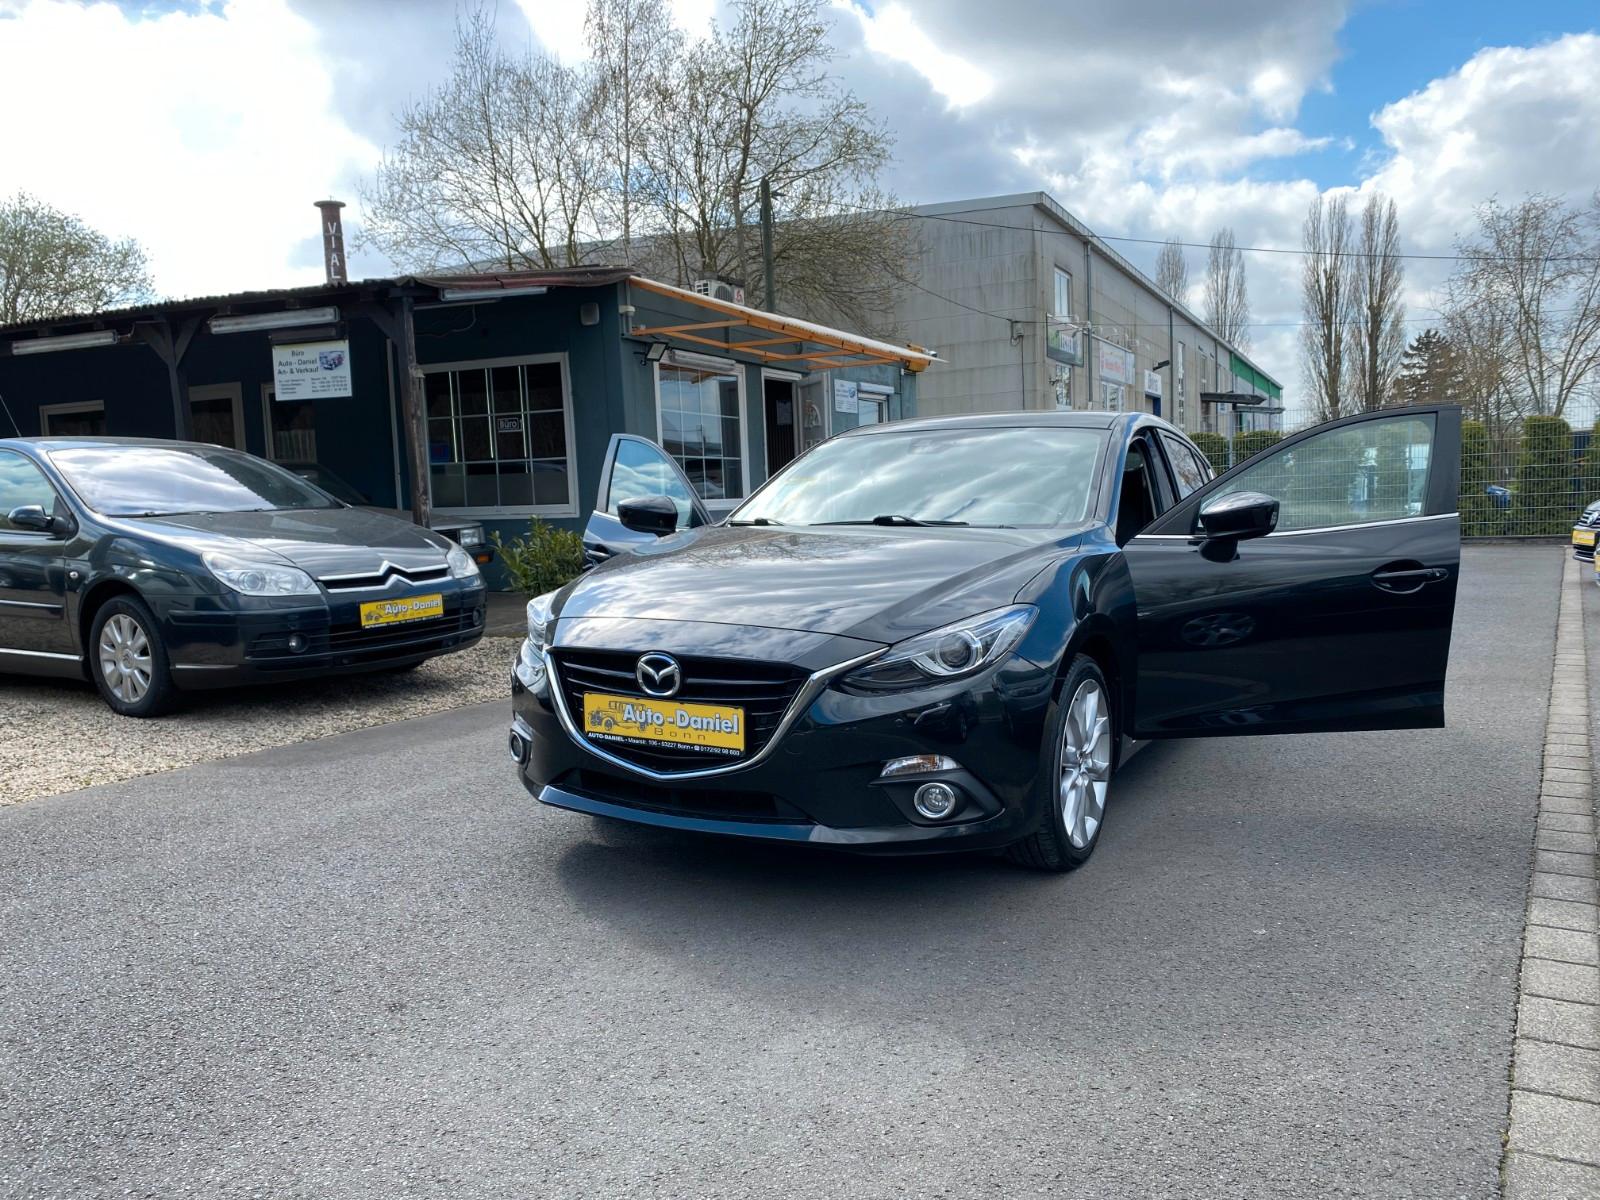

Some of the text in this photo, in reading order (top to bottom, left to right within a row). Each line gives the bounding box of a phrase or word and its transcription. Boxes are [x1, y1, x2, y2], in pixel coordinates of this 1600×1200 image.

[298, 358, 318, 366] Daniel
[295, 366, 319, 374] Verkauf
[588, 732, 625, 742] AUTO-DANIEL
